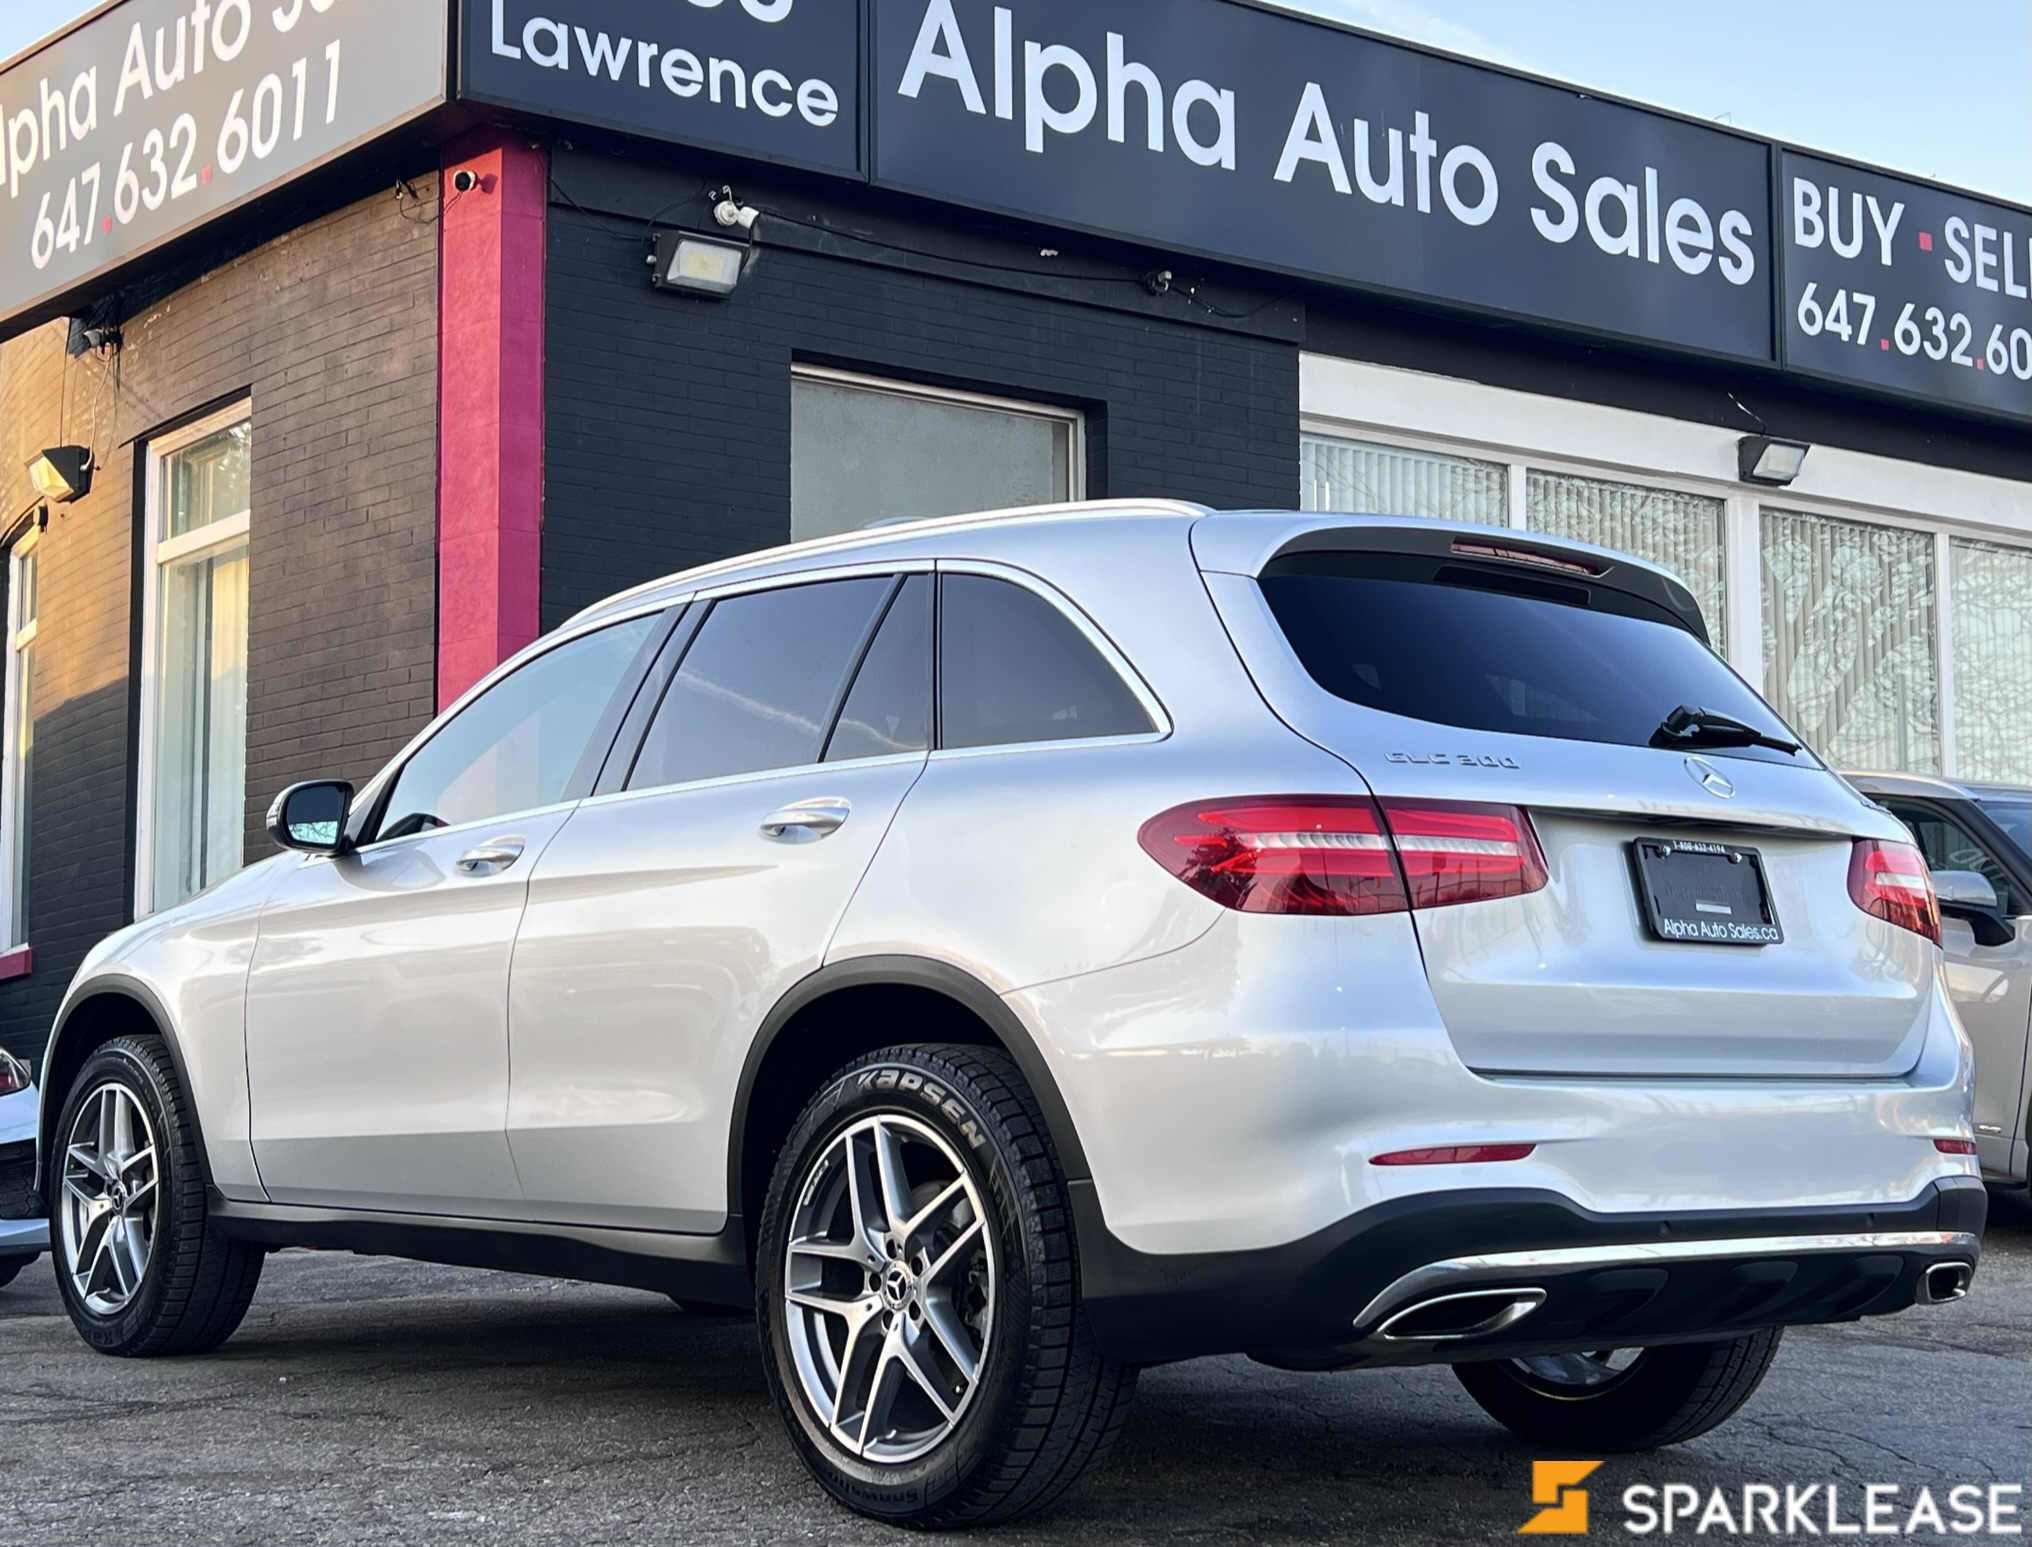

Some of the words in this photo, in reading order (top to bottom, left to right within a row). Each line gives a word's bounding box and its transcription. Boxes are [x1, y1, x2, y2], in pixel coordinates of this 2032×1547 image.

[113, 0, 250, 117] Auto
[491, 0, 838, 127] Lawrence
[31, 39, 340, 270] 647.632.6011
[897, 0, 1236, 171] Alpha
[1273, 82, 1499, 227] Auto
[1530, 141, 1756, 286] Sales
[1793, 176, 1905, 267] BUY
[1384, 751, 1450, 766] GLC
[1456, 754, 1521, 770] 300
[1664, 918, 1698, 938] Alpha
[1701, 920, 1728, 938] Auto
[1729, 922, 1779, 940] Sales.ca
